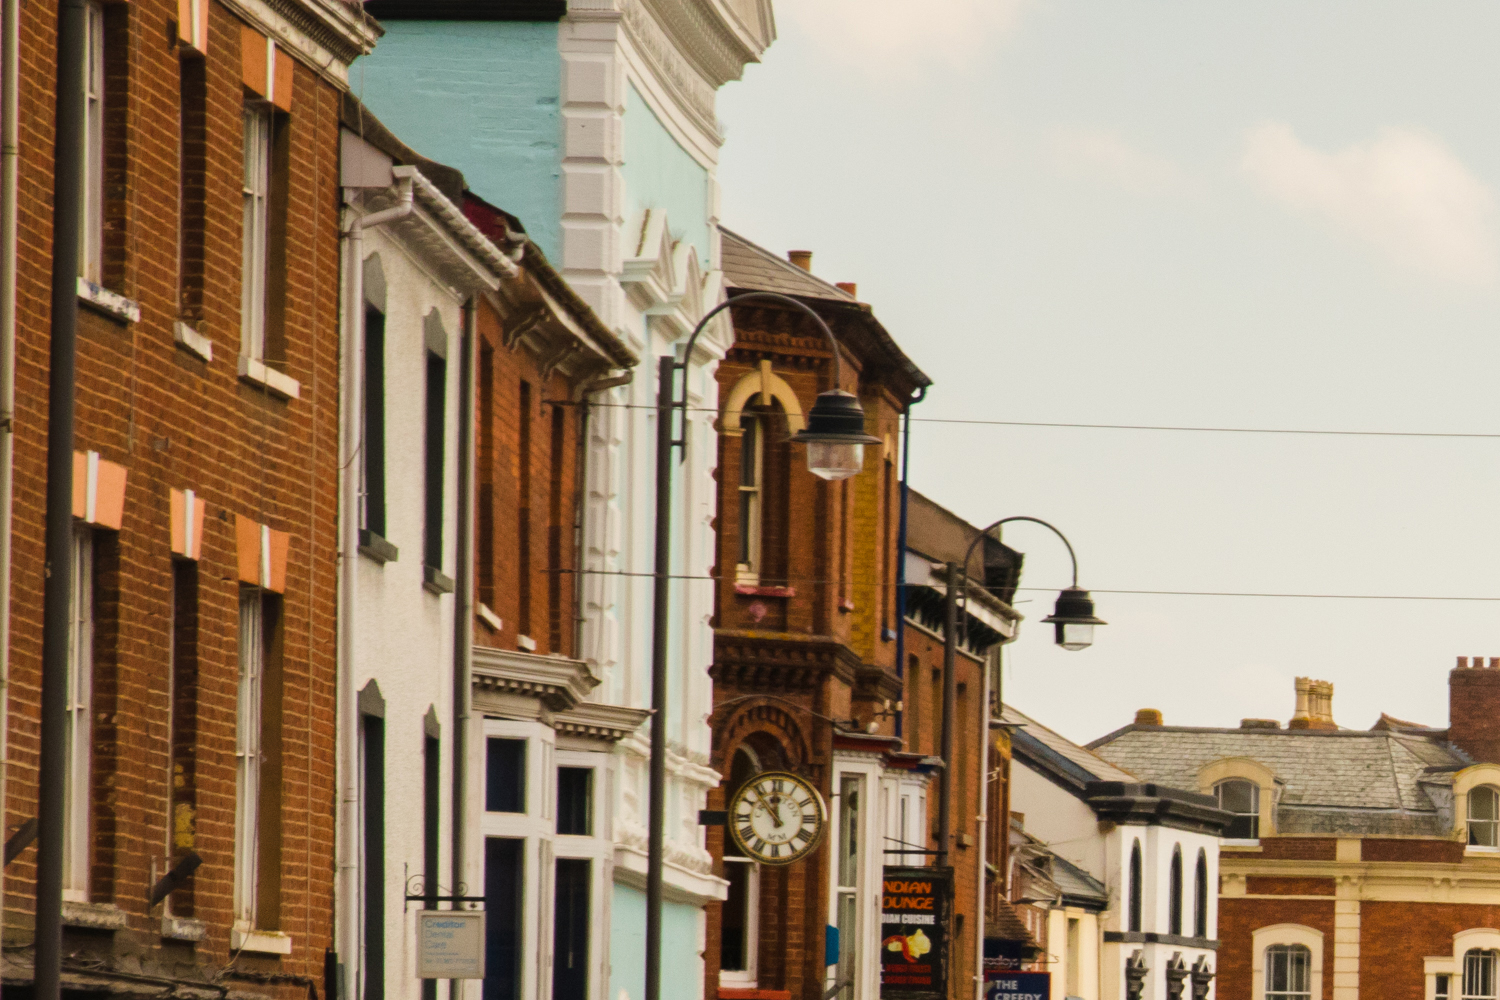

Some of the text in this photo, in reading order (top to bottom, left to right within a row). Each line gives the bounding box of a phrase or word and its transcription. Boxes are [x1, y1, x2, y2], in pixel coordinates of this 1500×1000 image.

[883, 880, 932, 894] NDIAN
[883, 896, 935, 910] OUNGE
[882, 913, 935, 925] DIAN CUISINE
[995, 980, 1018, 990] THE
